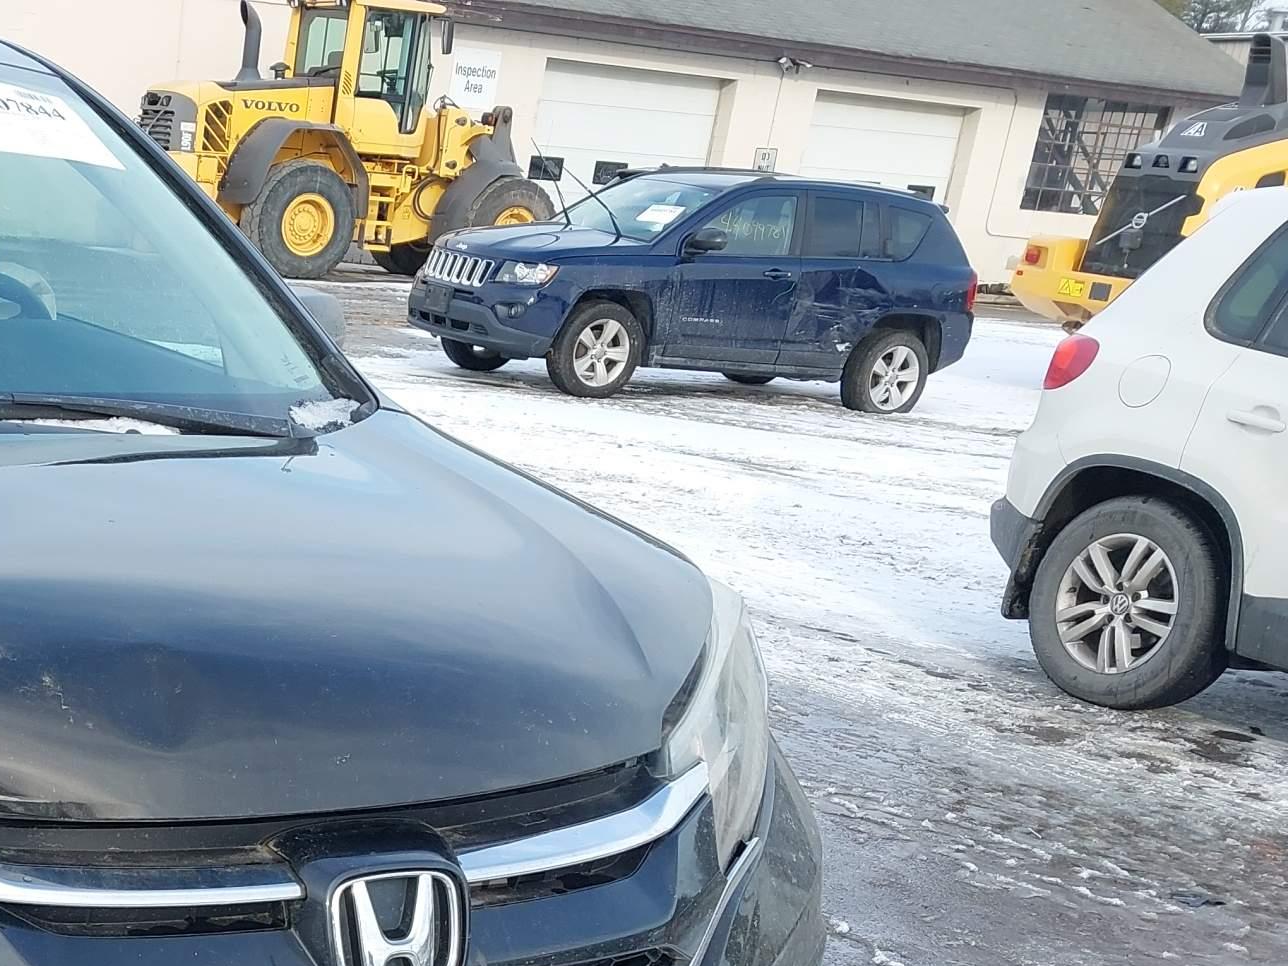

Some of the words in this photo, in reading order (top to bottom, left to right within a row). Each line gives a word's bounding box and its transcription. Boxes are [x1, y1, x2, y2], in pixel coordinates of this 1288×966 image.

[455, 61, 496, 79] Inspection
[464, 80, 483, 94] Area
[242, 99, 300, 113] VOLVO
